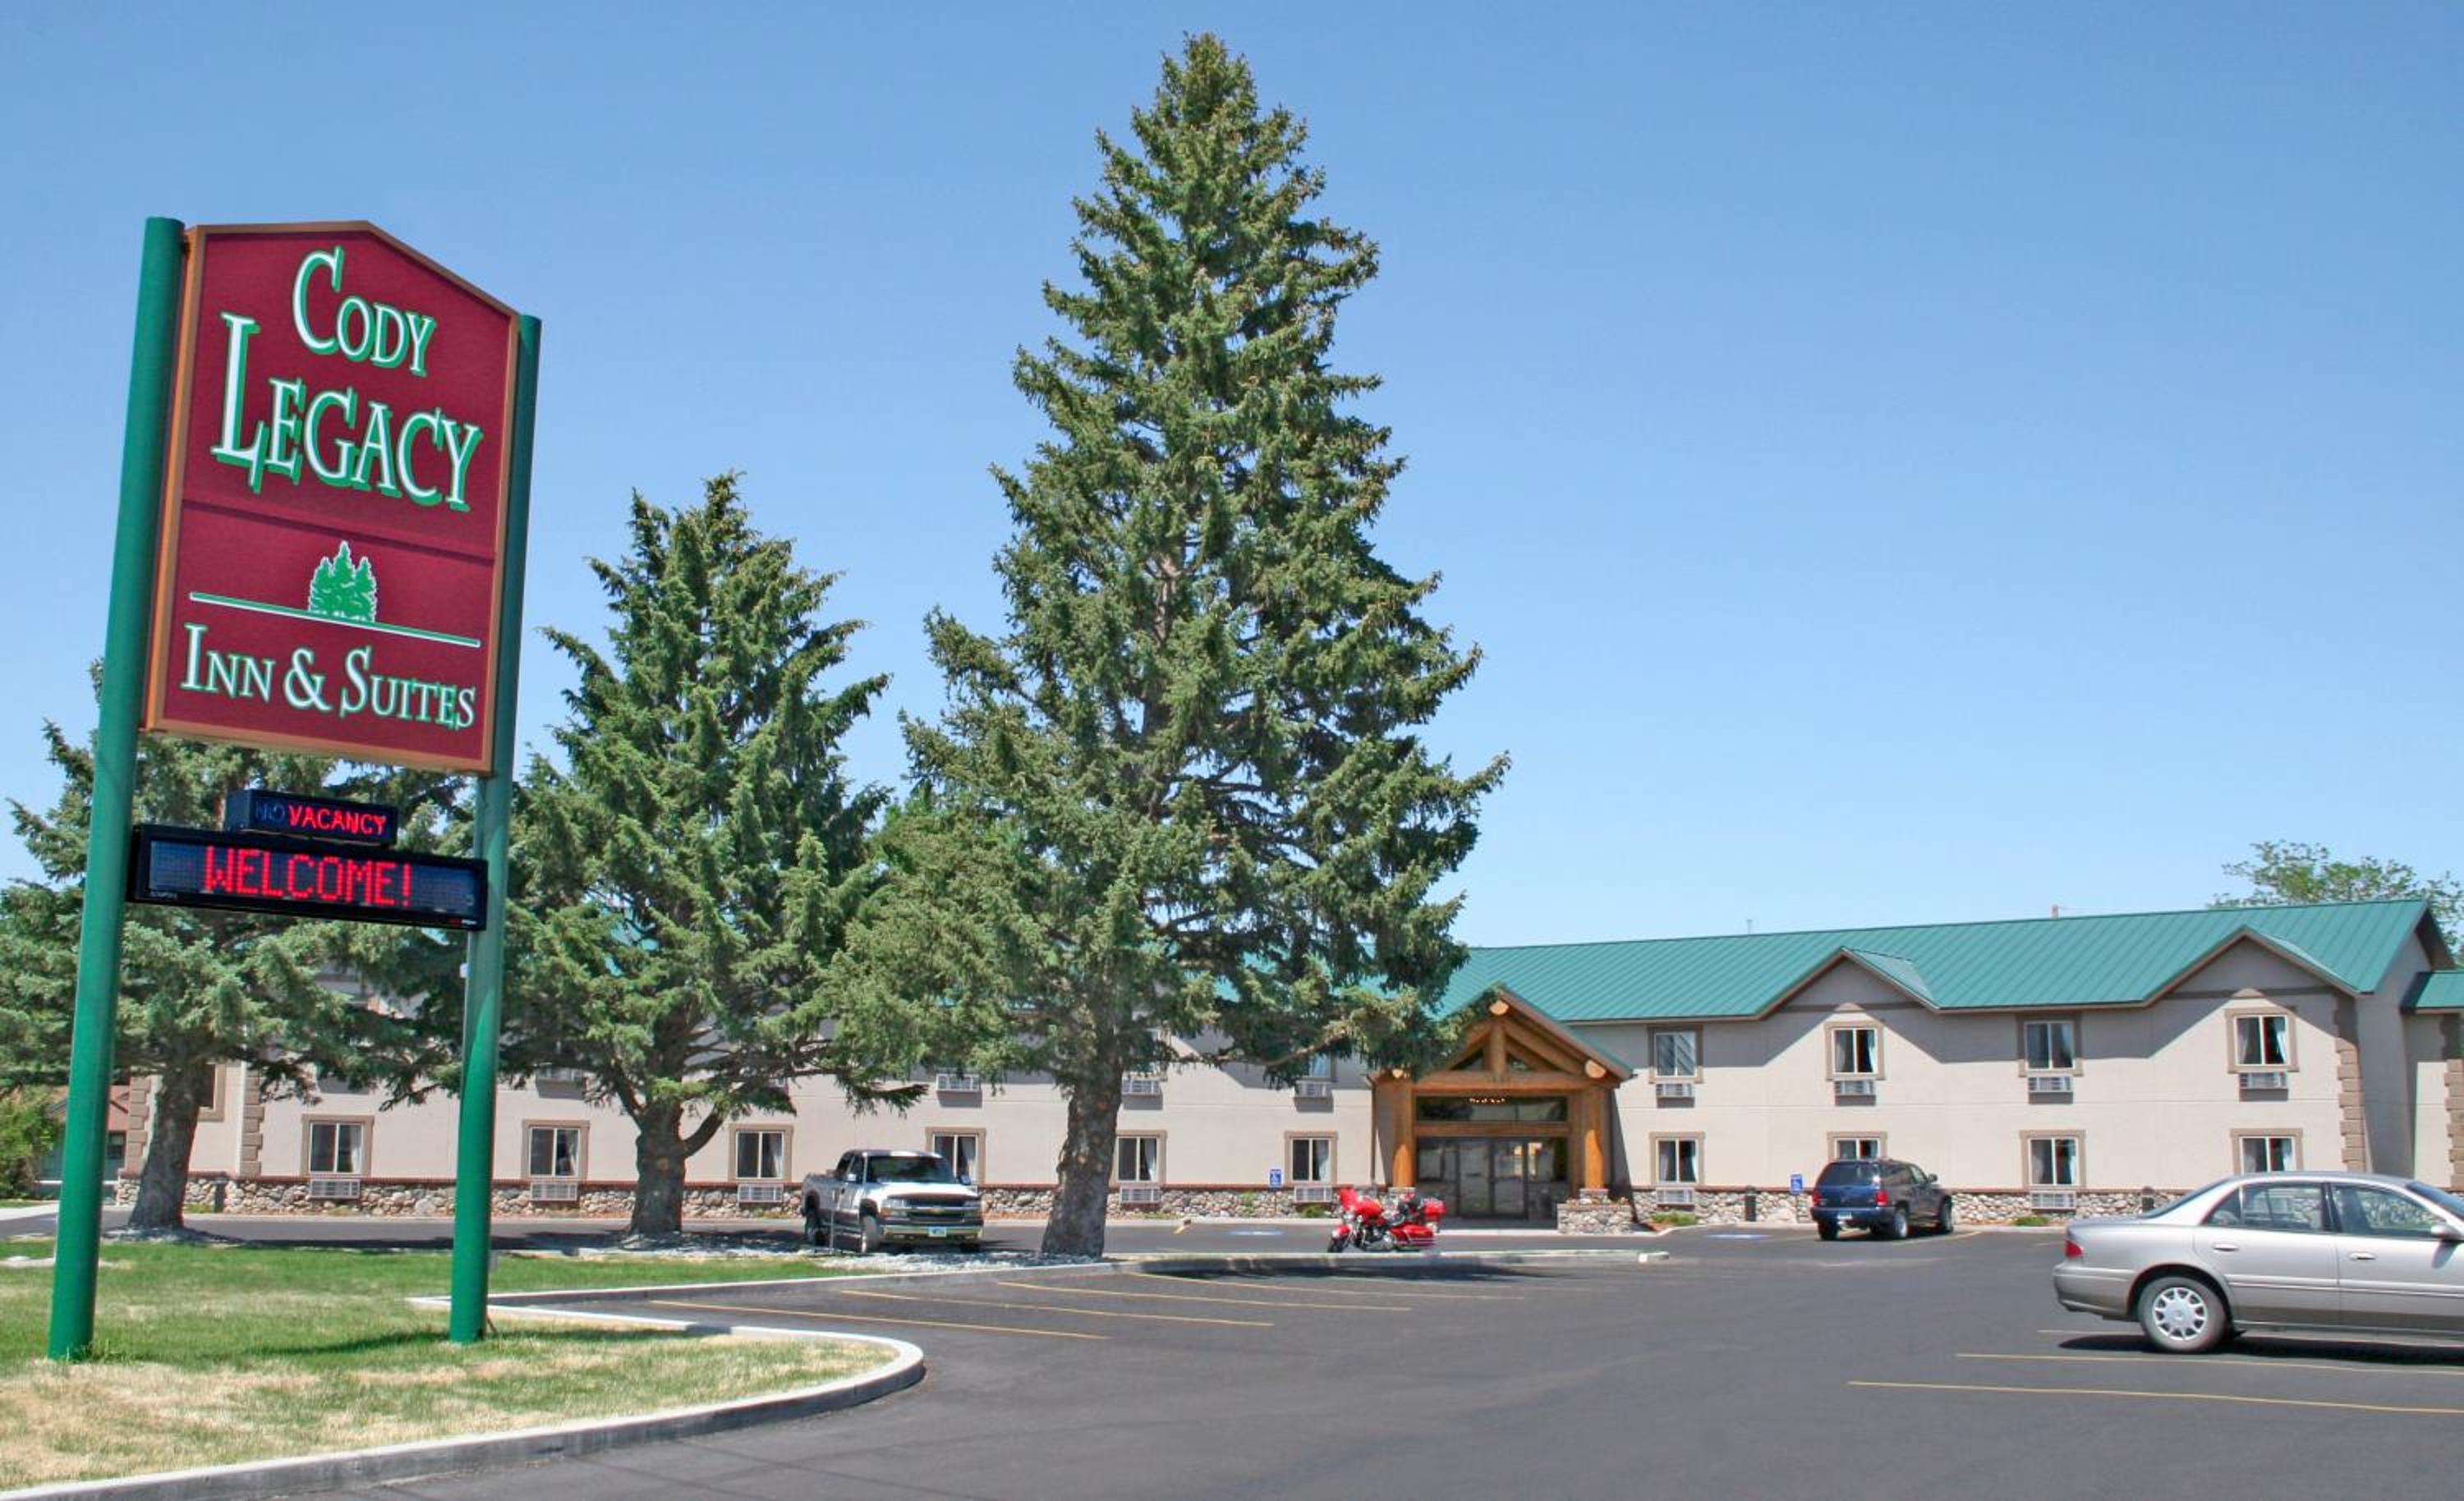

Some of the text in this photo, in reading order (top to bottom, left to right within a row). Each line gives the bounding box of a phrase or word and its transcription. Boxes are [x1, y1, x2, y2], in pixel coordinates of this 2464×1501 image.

[292, 246, 436, 375] CODY
[210, 312, 484, 512] LEGACY
[180, 622, 476, 729] INN & SUITES
[255, 801, 387, 835] NO VACANCY
[204, 846, 412, 907] WELCOME!
